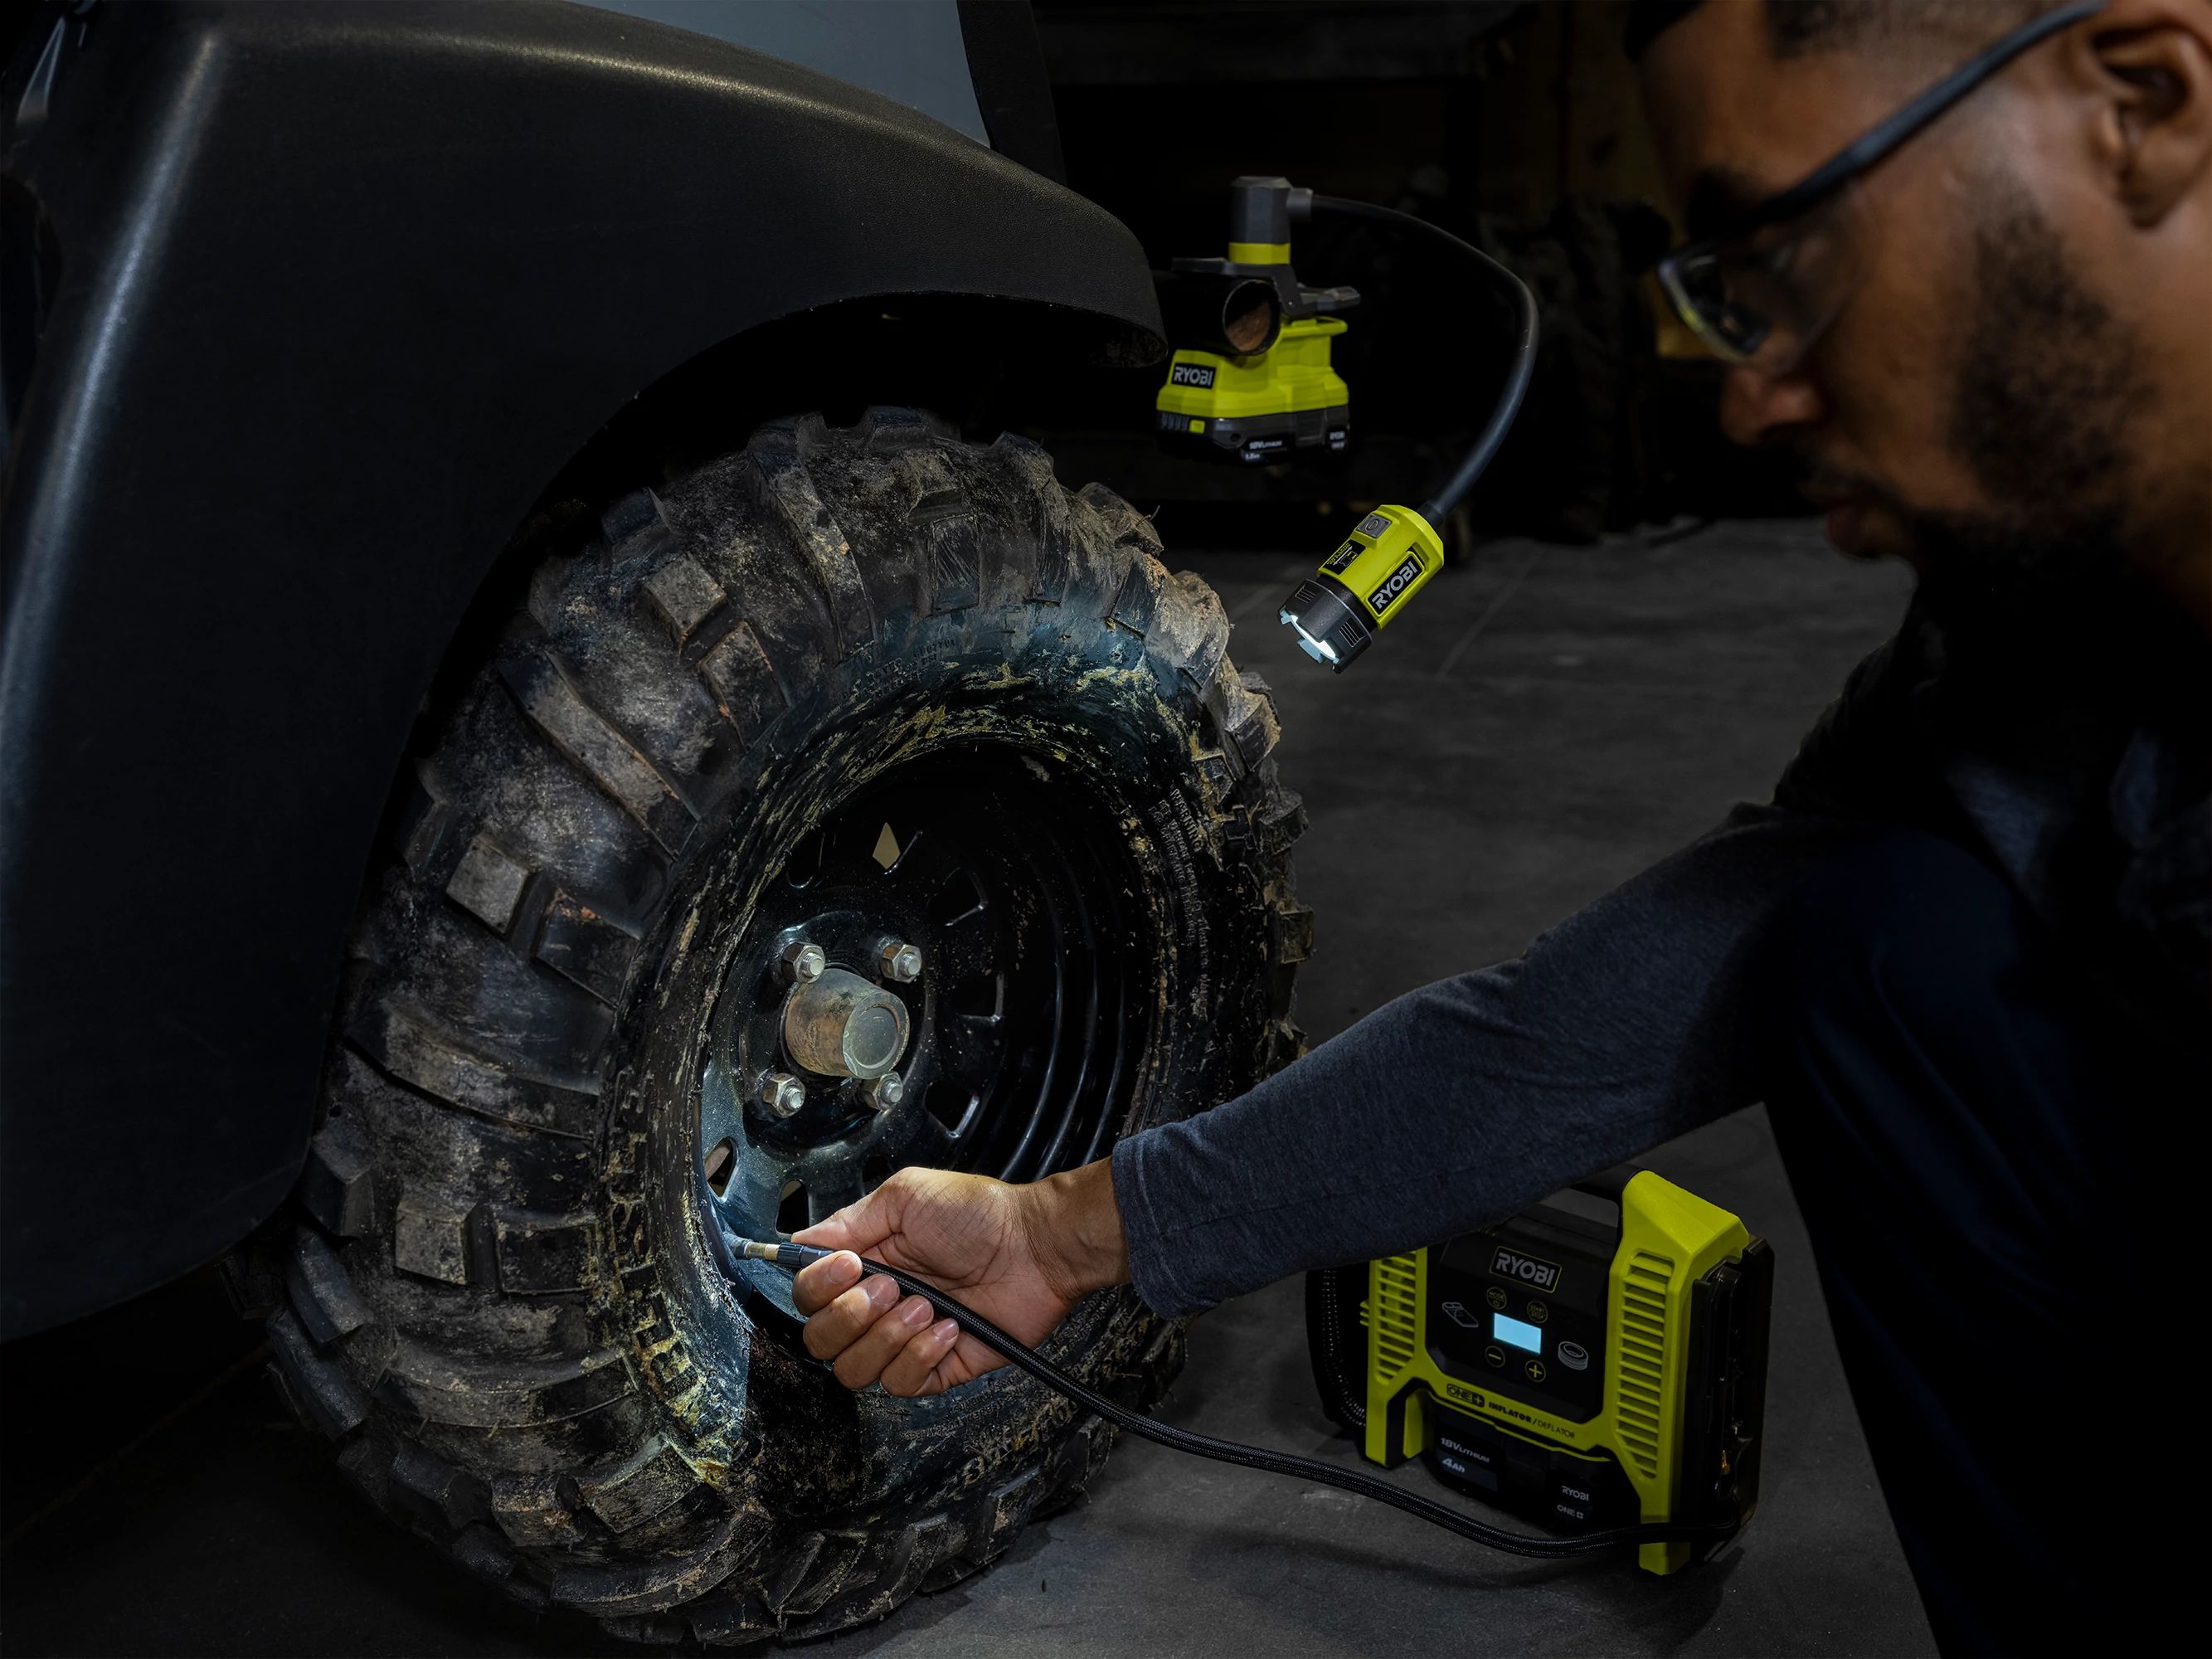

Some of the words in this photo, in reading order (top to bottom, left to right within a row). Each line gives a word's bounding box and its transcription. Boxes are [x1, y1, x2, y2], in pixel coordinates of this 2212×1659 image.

[1173, 366, 1214, 387] RYOBI
[1371, 561, 1418, 609] RYOBI
[1170, 788, 1203, 853] WARNING
[1495, 1252, 1557, 1287] RYOBI
[1489, 1402, 1533, 1424] INFLATOR
[1561, 1485, 1590, 1502] RYOBI
